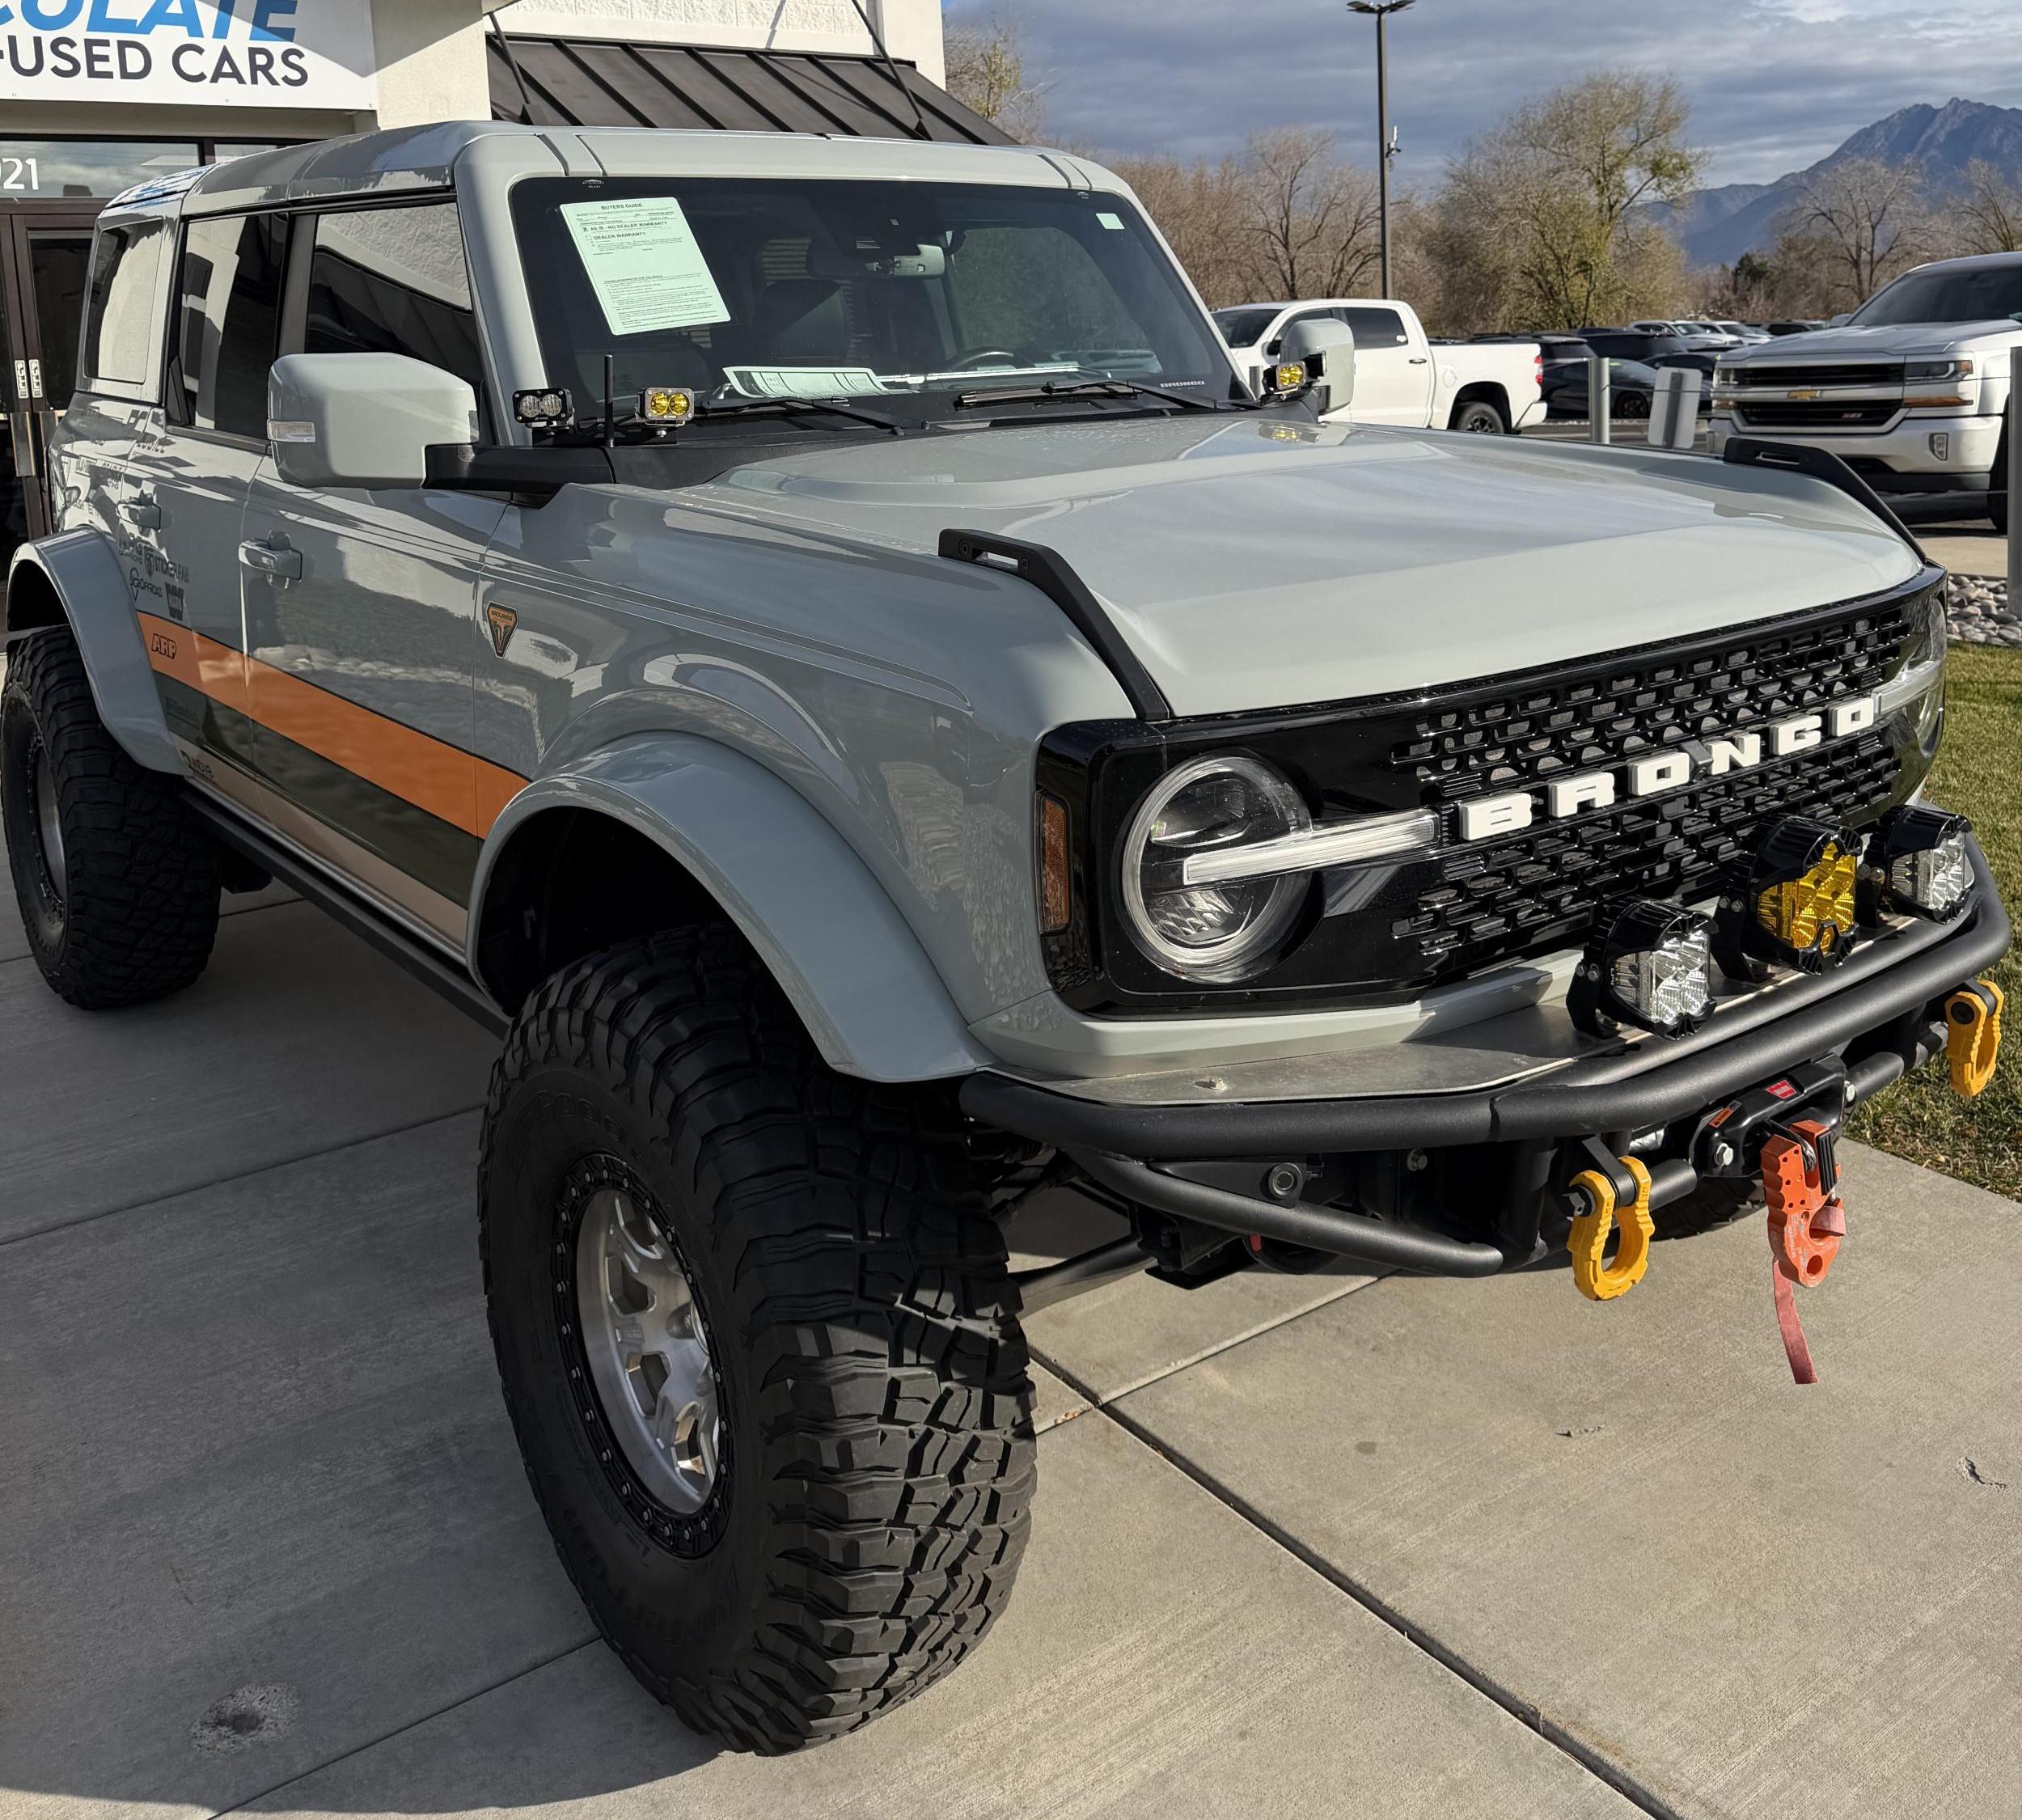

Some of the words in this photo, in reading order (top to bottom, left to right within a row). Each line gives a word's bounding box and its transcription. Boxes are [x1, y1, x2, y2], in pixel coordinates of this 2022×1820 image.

[0, 35, 152, 80] USED
[171, 43, 309, 87] CARS
[0, 158, 39, 190] 21
[1460, 696, 1874, 842] BRONCO
